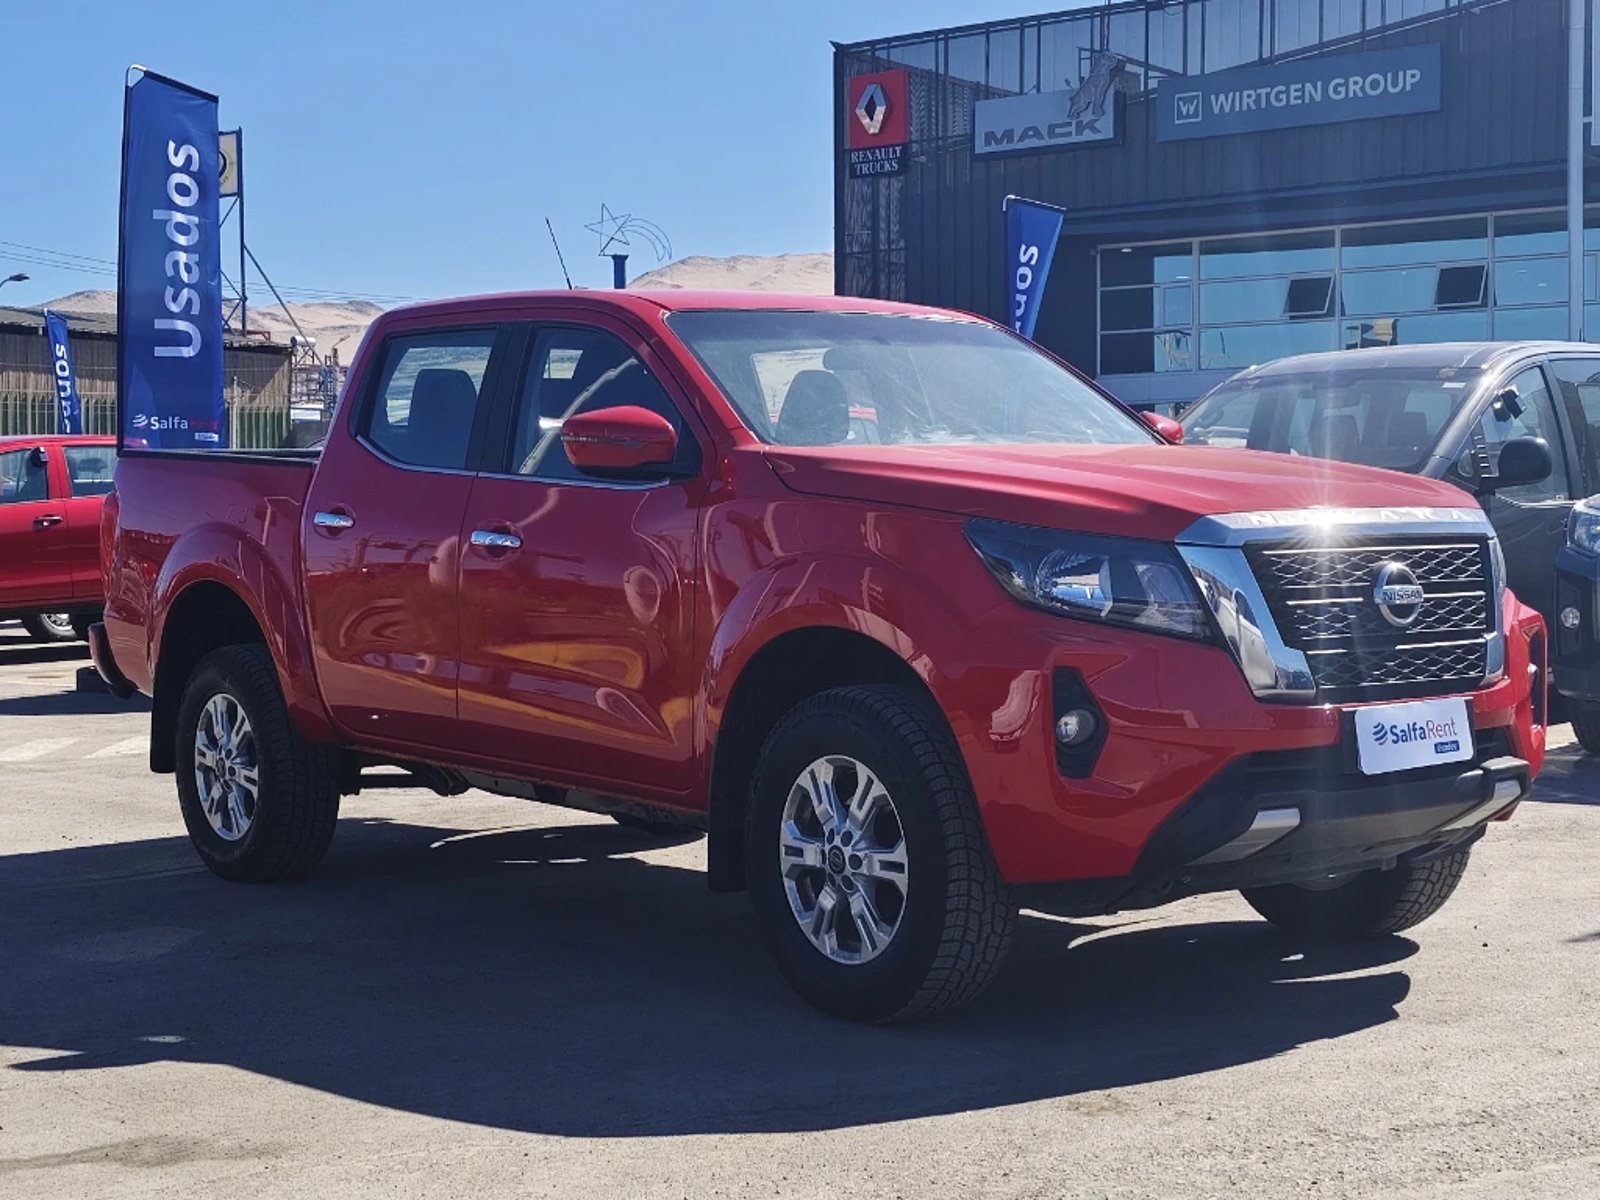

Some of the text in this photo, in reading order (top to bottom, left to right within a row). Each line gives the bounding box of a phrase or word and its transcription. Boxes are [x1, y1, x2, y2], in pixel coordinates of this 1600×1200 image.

[1210, 80, 1322, 114] WIRTGEN
[1328, 69, 1421, 100] GROUP
[983, 118, 1103, 147] MACK
[851, 146, 902, 163] RENAULT
[855, 159, 898, 175] TRUCKS
[152, 139, 202, 358] Usados
[1382, 590, 1421, 601] NISSAN
[1389, 718, 1458, 745] SalfaRent
